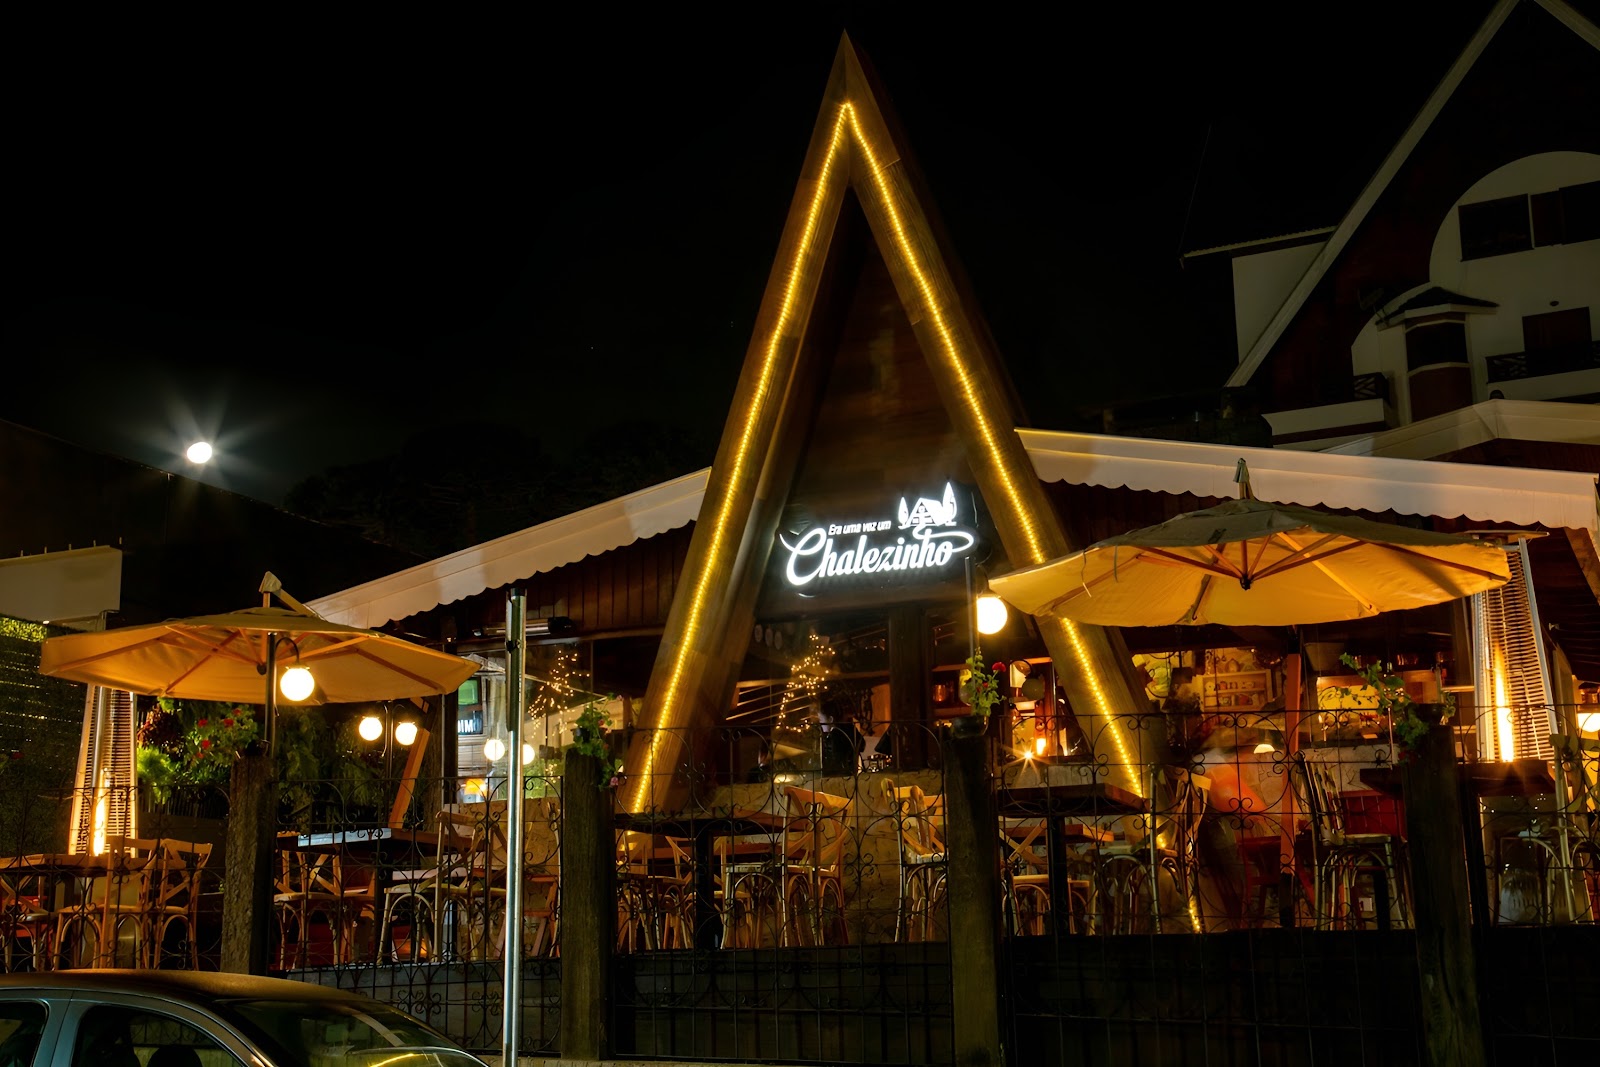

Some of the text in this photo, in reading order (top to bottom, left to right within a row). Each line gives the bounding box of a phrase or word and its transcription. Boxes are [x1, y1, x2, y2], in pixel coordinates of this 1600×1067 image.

[828, 519, 892, 536] Era uma vez um
[779, 527, 975, 587] Chalezinho
